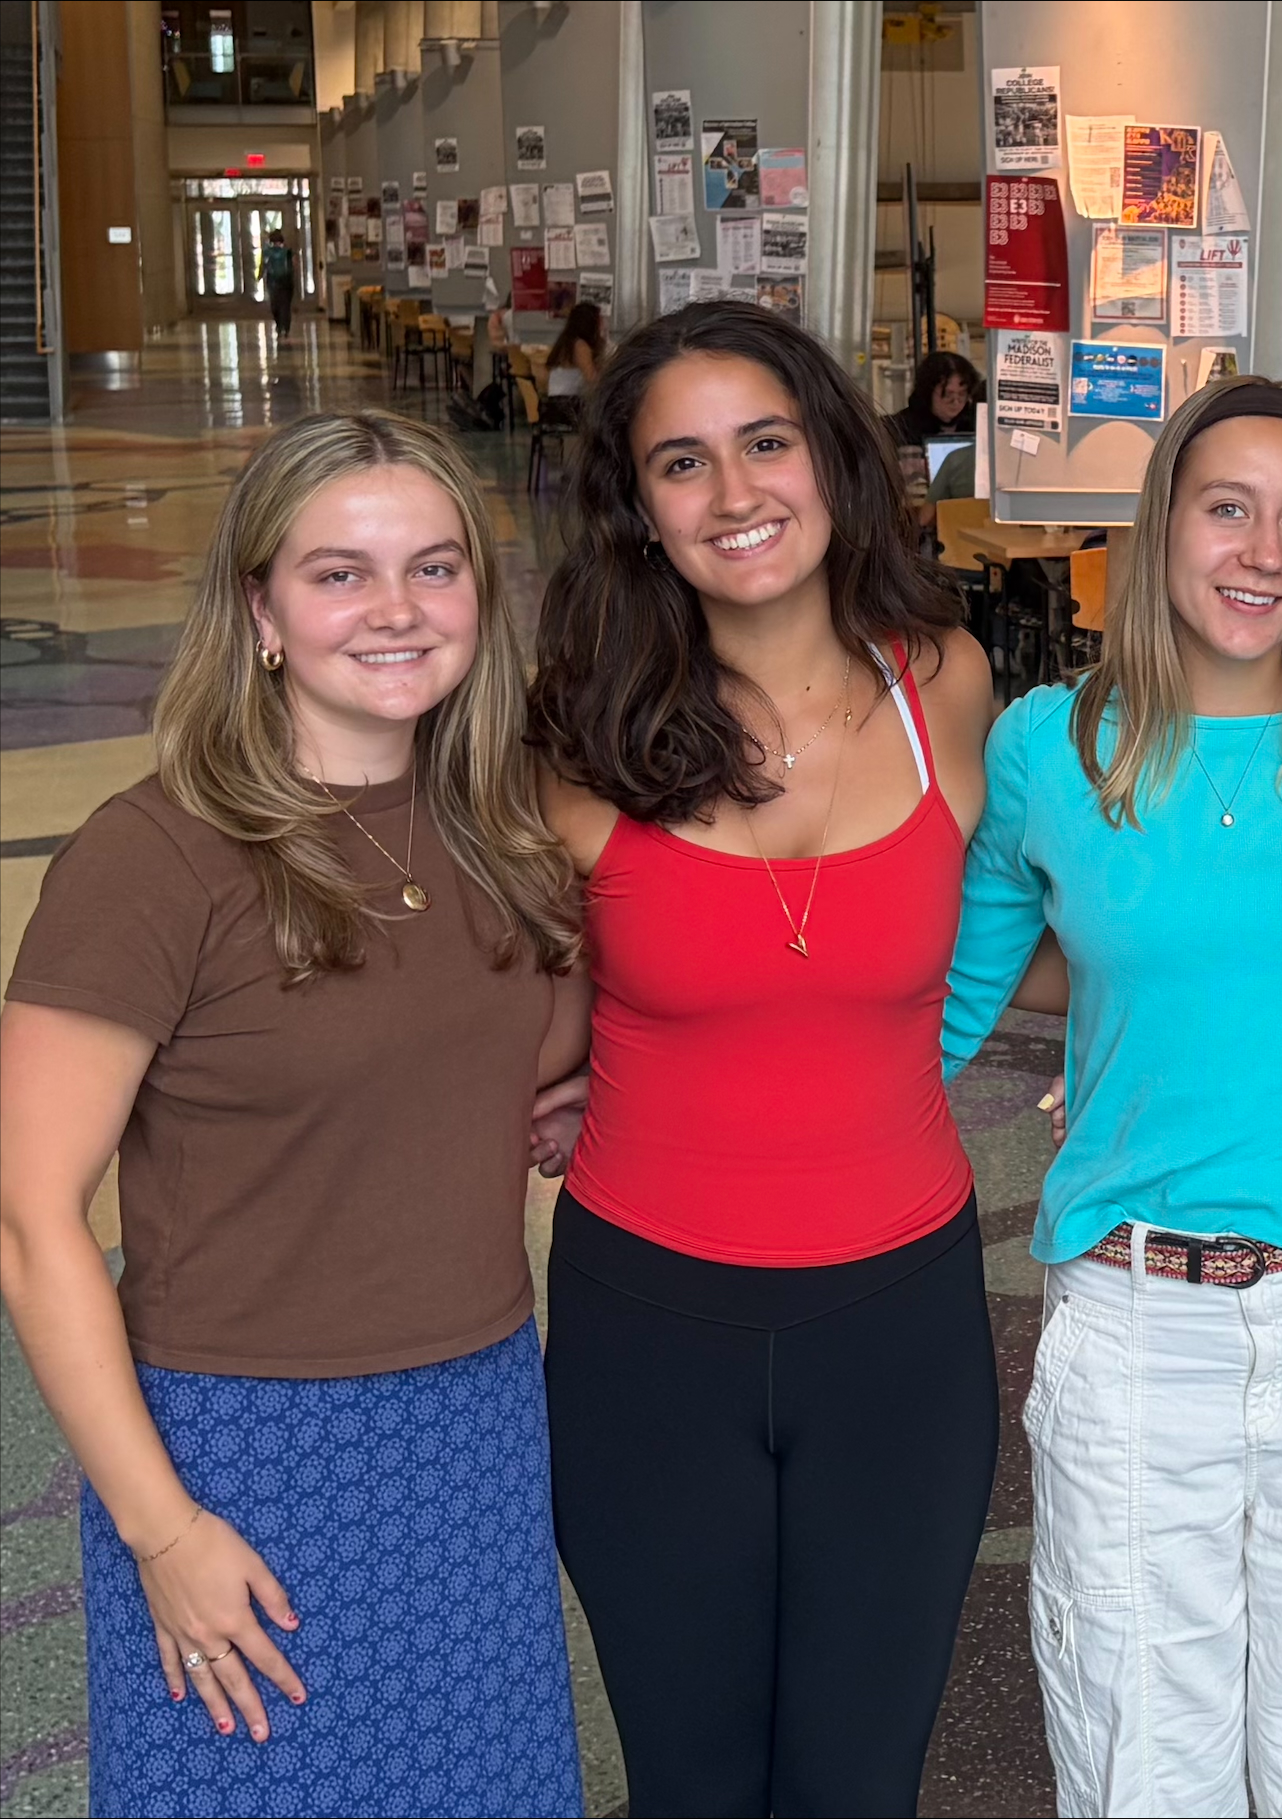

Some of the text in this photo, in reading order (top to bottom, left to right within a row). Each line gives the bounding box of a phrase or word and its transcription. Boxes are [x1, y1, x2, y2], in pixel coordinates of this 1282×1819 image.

[1006, 78, 1044, 87] COLLEGE
[1009, 199, 1028, 214] E3
[1199, 249, 1226, 261] LIFT
[1007, 343, 1051, 356] MADISON
[1004, 354, 1054, 368] FEDERALIST
[999, 404, 1013, 412] SIGN
[1024, 406, 1045, 414] TODAY
